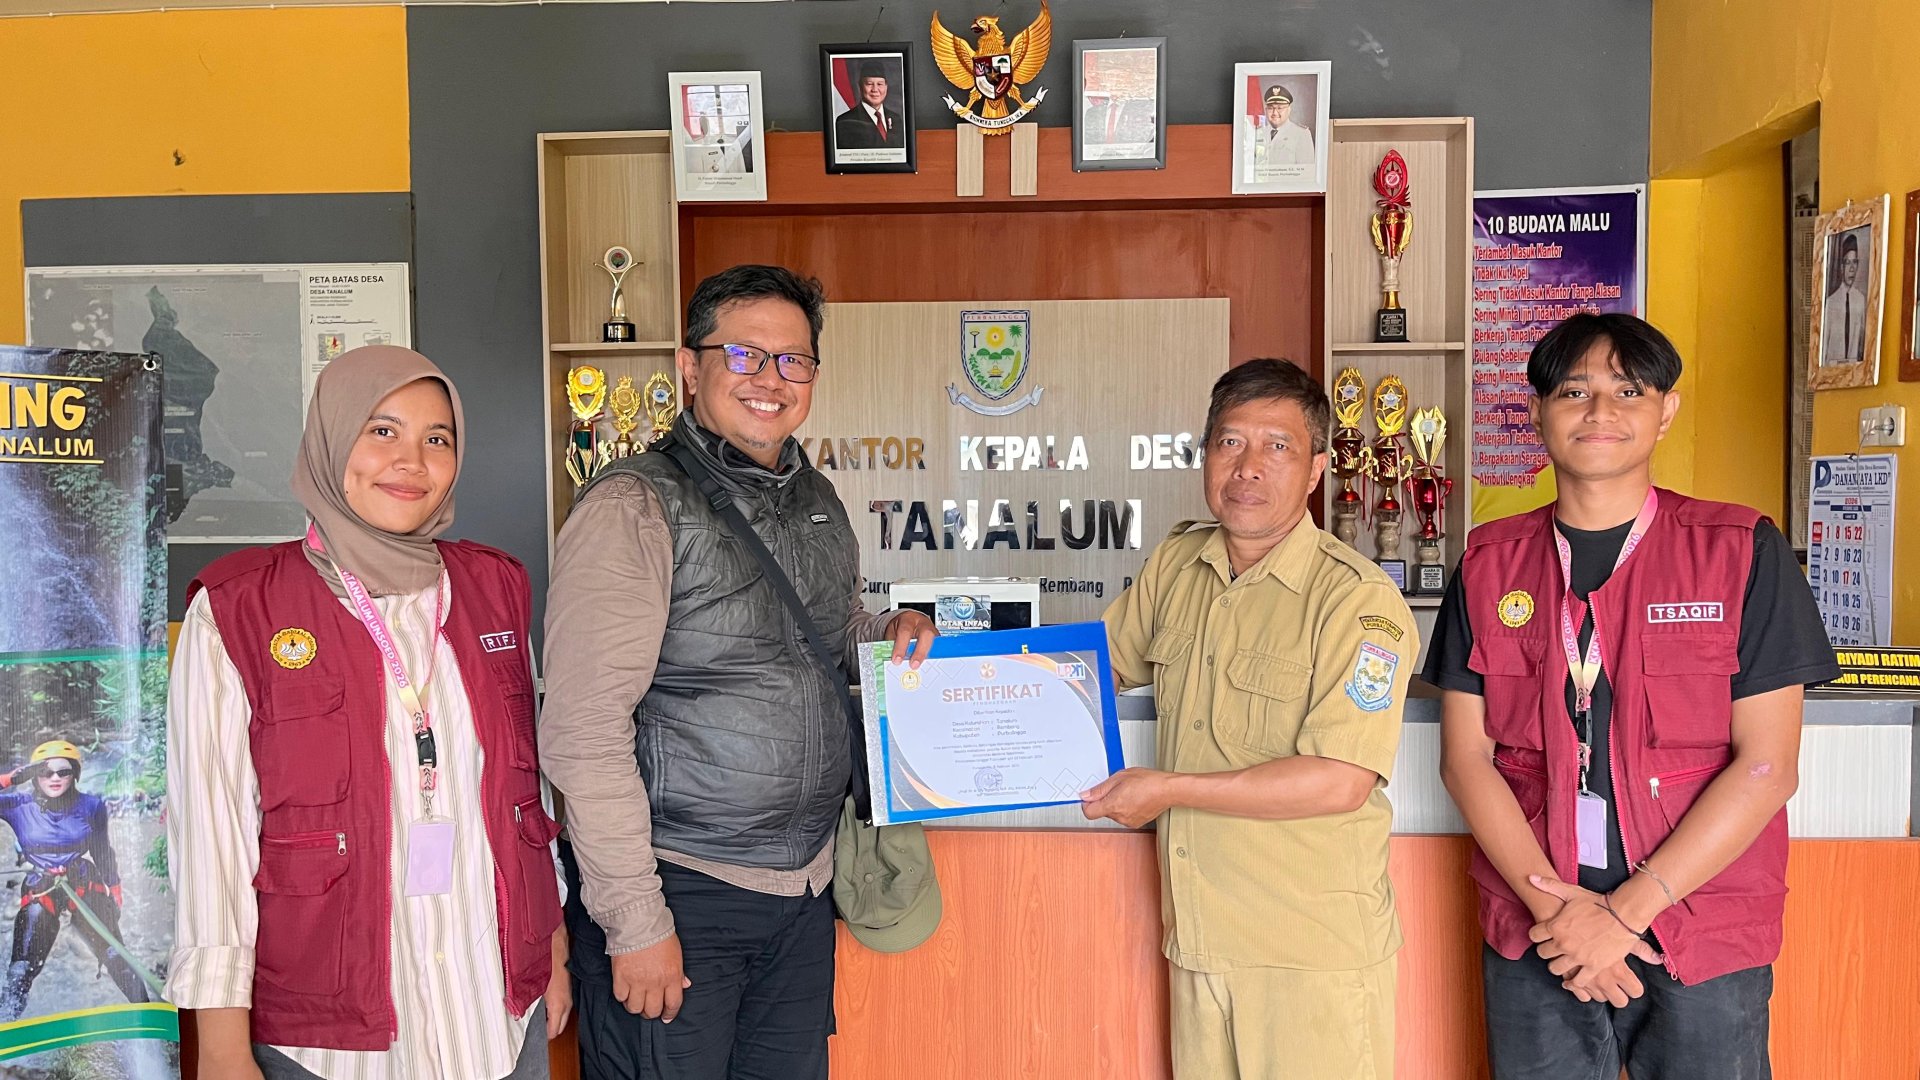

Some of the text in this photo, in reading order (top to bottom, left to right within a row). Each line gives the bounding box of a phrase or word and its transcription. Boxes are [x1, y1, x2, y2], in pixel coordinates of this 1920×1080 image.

[1487, 213, 1610, 235] 10 BUDAYA MALU
[1474, 242, 1563, 261] Terlambat Masuk Kantor
[309, 276, 330, 284] PETA
[361, 275, 384, 283] DESA
[1474, 265, 1529, 283] Tidak Ikut Apel
[1474, 283, 1621, 304] Sering Tidak Masuk Kantor Tanpa Alasan
[1474, 308, 1497, 325] Sering
[1499, 306, 1519, 322] Minta
[1533, 305, 1555, 321] Tidak
[1506, 326, 1529, 345] Tanpa
[1474, 348, 1531, 367] Pulang Sebelum
[1474, 369, 1497, 387] Sering
[1474, 388, 1529, 407] Alasan Penting
[1506, 409, 1530, 428] Tanpa
[959, 435, 1090, 471] KEPALA
[1479, 451, 1520, 469] Berpakaian
[1479, 470, 1536, 489] Atribut Lengkap
[869, 499, 1142, 551] TANALUM
[1835, 525, 1840, 540] 8
[1844, 526, 1852, 540] 15
[1854, 526, 1863, 541] 22
[1623, 532, 1641, 560] 2026
[1824, 547, 1829, 561] 2
[1834, 547, 1840, 562] 9
[1843, 548, 1851, 562] 16
[1853, 548, 1862, 563] 23
[1823, 568, 1828, 583] 3
[1832, 569, 1840, 584] 10
[1842, 570, 1850, 585] 17
[1852, 571, 1861, 586] 24
[1039, 577, 1104, 598] Rembang
[1823, 590, 1828, 605] 4
[1832, 592, 1839, 606] 11
[1842, 593, 1850, 608] 18
[1852, 594, 1861, 609] 25
[1654, 606, 1717, 619] TSAQIF
[345, 573, 408, 689] TANALUM UNSOED 2026
[1832, 614, 1839, 628] 12
[1842, 616, 1850, 630] 19
[1852, 617, 1861, 632] 26
[1566, 637, 1578, 663] 2026
[1836, 652, 1880, 666] RIYADI
[942, 683, 1043, 703] SERTIFIKAT
